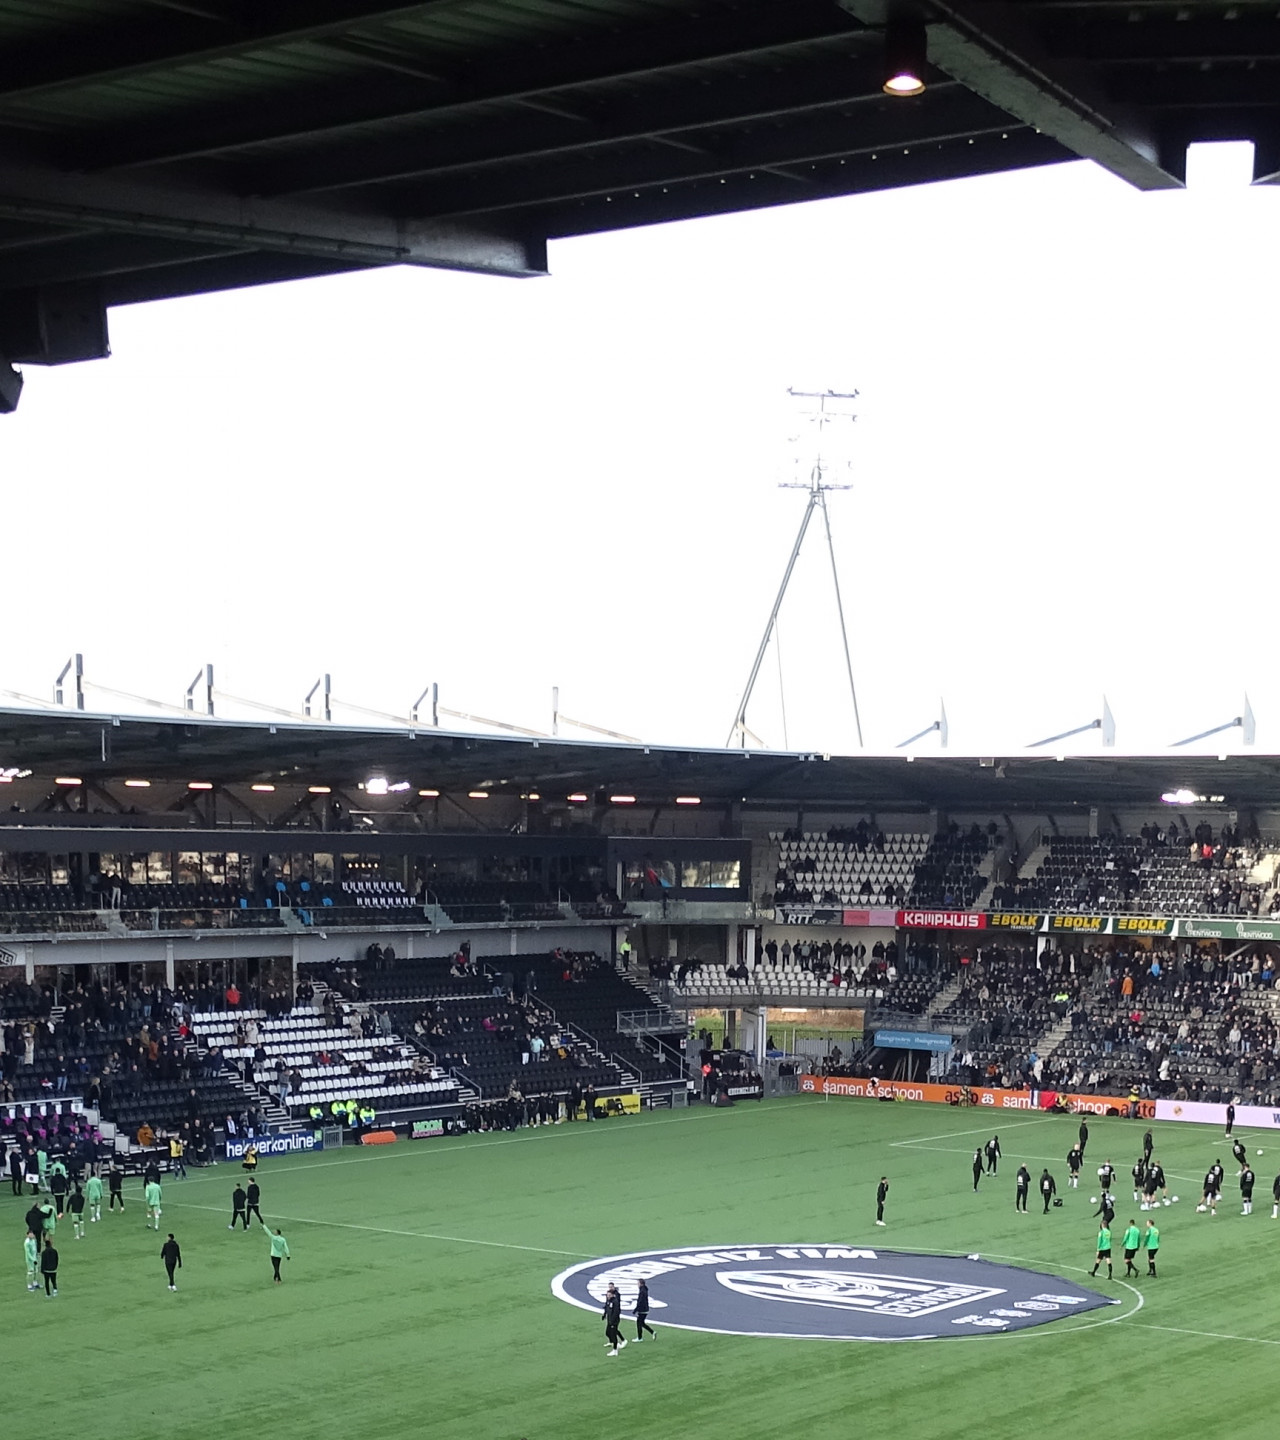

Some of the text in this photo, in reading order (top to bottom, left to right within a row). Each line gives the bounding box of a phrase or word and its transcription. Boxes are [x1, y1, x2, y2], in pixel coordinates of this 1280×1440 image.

[787, 914, 813, 925] RTT
[903, 912, 979, 928] KAMPHUIS
[1001, 914, 1038, 926] BOLK
[1063, 917, 1102, 928] BOLK
[1127, 919, 1168, 931] BOLK
[822, 1080, 864, 1095] samen
[945, 1090, 979, 1104] aso
